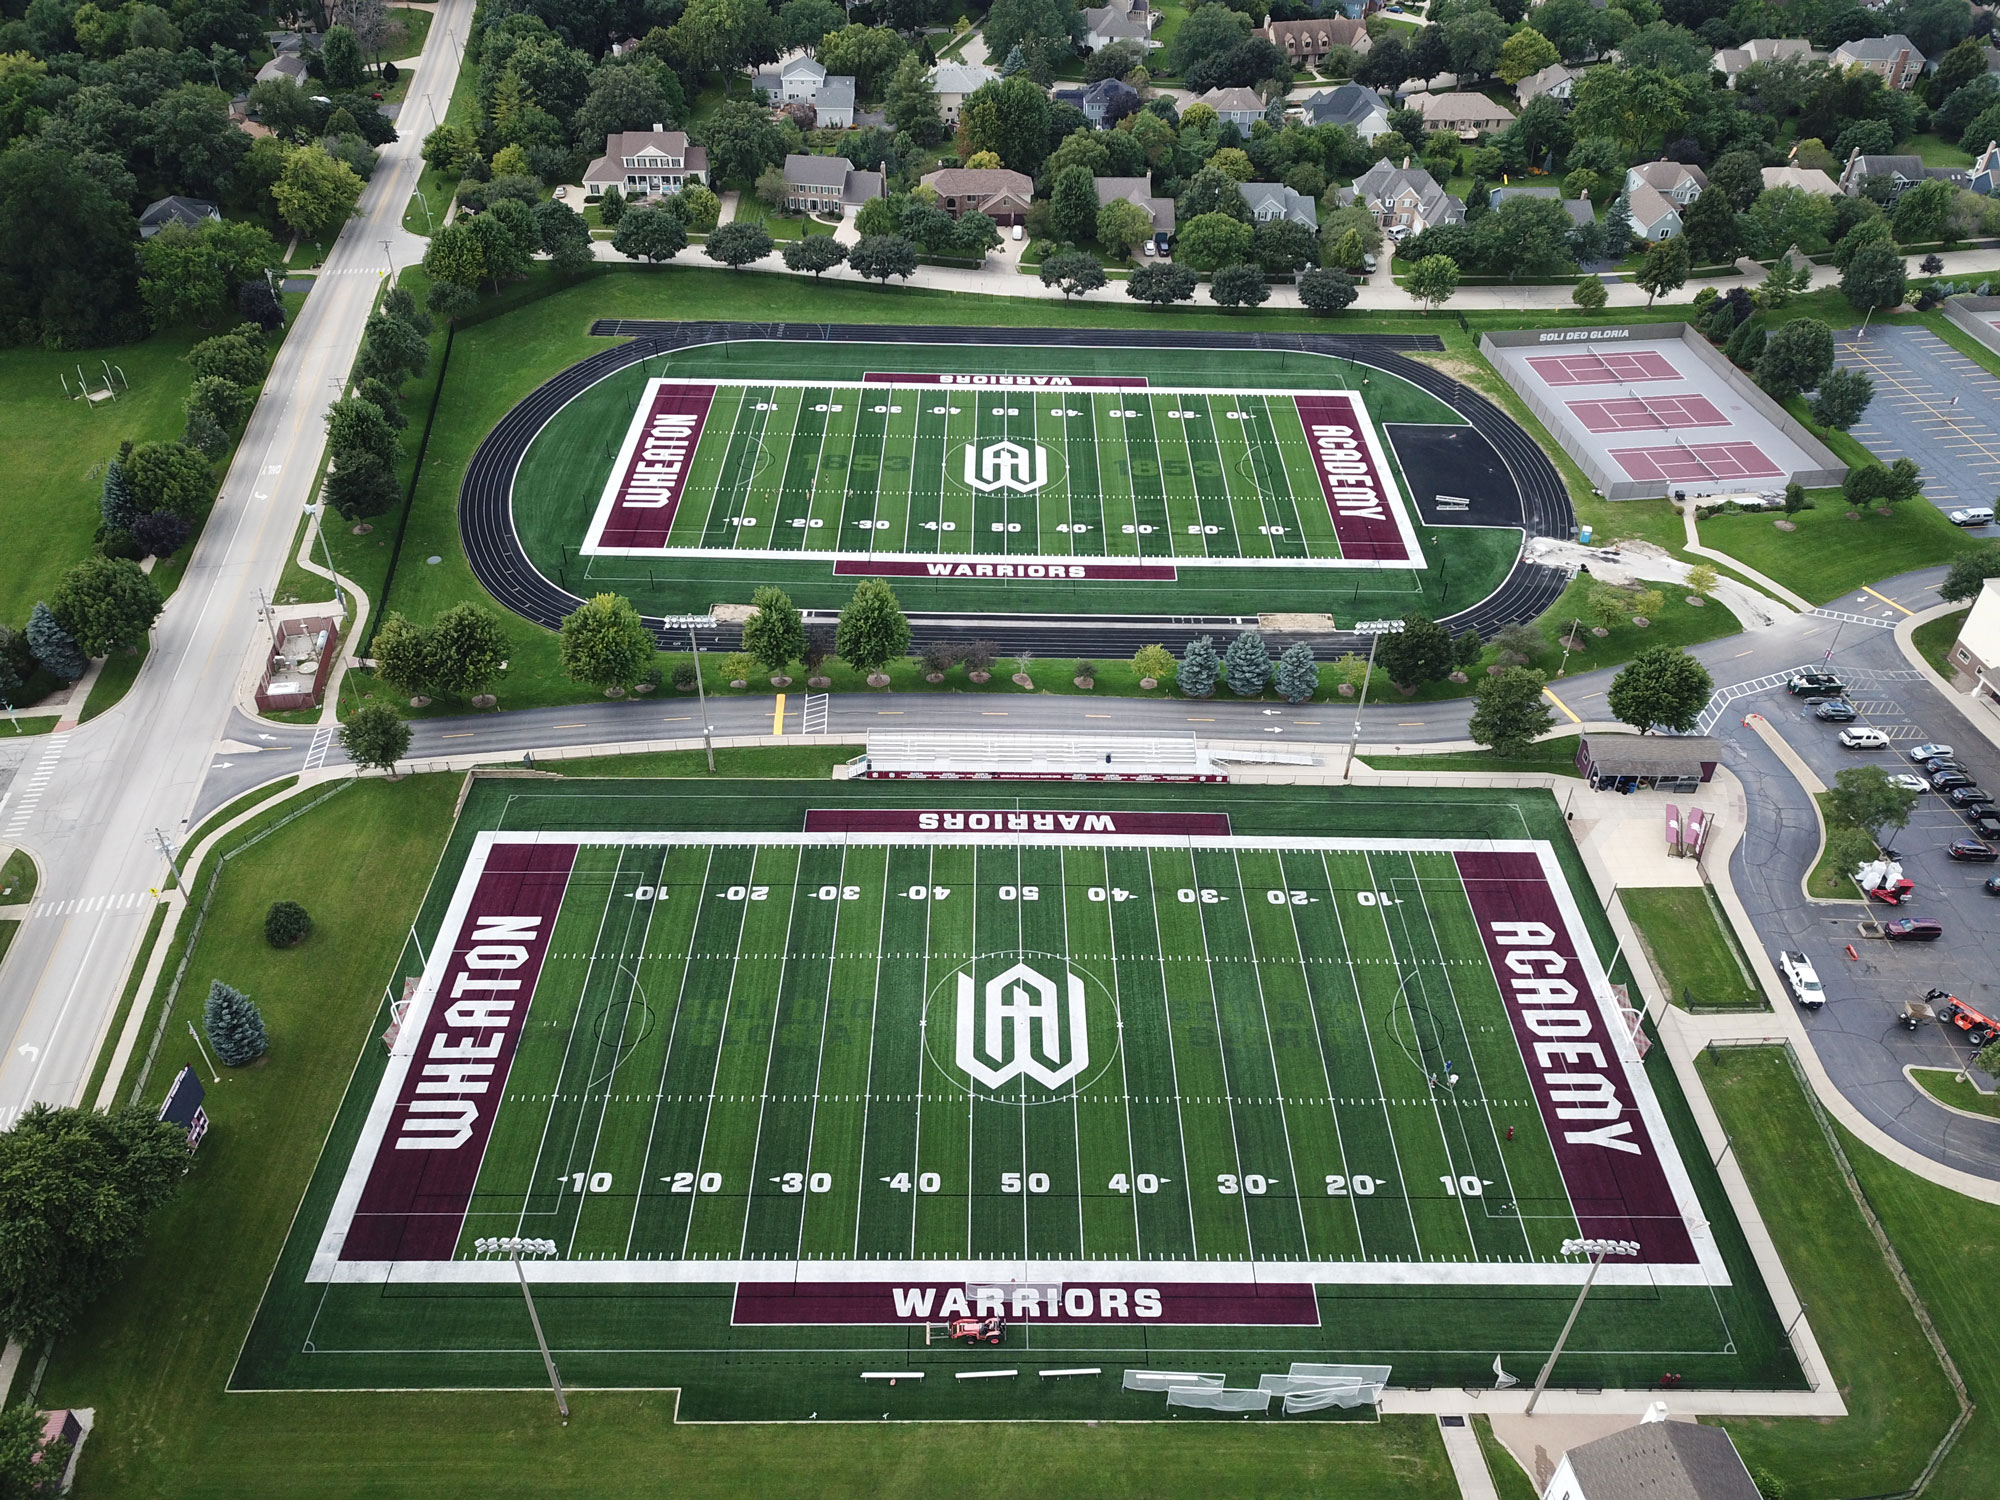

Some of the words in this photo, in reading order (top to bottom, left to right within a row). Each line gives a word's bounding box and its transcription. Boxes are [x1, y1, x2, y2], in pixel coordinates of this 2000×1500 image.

[1539, 332, 1565, 342] SOLI
[1566, 331, 1588, 341] DEO
[1589, 329, 1630, 339] GLORIA
[939, 374, 1073, 385] WARRIORS
[754, 402, 778, 411] 10
[815, 404, 843, 412] 20
[873, 405, 902, 413] 30
[933, 406, 961, 415] 40
[992, 408, 1019, 416] 50
[1051, 408, 1079, 417] 40
[1109, 409, 1137, 418] 30
[1167, 410, 1196, 419] 20
[1226, 411, 1252, 419] 10
[622, 413, 698, 508] WHEATON
[803, 454, 911, 471] 1853
[1114, 460, 1221, 477] 1853
[1311, 424, 1386, 521] ACADEMY
[731, 517, 757, 526] 10
[791, 519, 824, 528] 20
[857, 520, 890, 530] 30
[924, 521, 956, 531] 40
[991, 522, 1022, 532] 50
[1056, 523, 1087, 533] 40
[1122, 524, 1153, 534] 30
[1187, 525, 1220, 535] 20
[1258, 525, 1286, 535] 10
[927, 563, 1086, 578] WARRIORS
[918, 813, 1116, 832] WARRIORS
[635, 885, 670, 900] 10
[726, 886, 770, 900] 20
[818, 886, 861, 900] 30
[908, 886, 951, 900] 40
[999, 886, 1039, 900] 50
[1087, 887, 1131, 902] 40
[1177, 888, 1220, 903] 30
[1266, 890, 1309, 905] 20
[1357, 891, 1394, 906] 10
[394, 916, 543, 1150] WHEATON
[1490, 921, 1642, 1155] ACADEMY
[571, 1172, 613, 1193] 10
[670, 1172, 723, 1193] 20
[781, 1173, 832, 1193] 30
[889, 1173, 941, 1193] 40
[1000, 1173, 1050, 1193] 50
[1108, 1173, 1159, 1194] 40
[1217, 1174, 1268, 1195] 30
[1325, 1175, 1376, 1196] 20
[1439, 1176, 1484, 1197] 10
[892, 1287, 1163, 1318] WARRIORS
